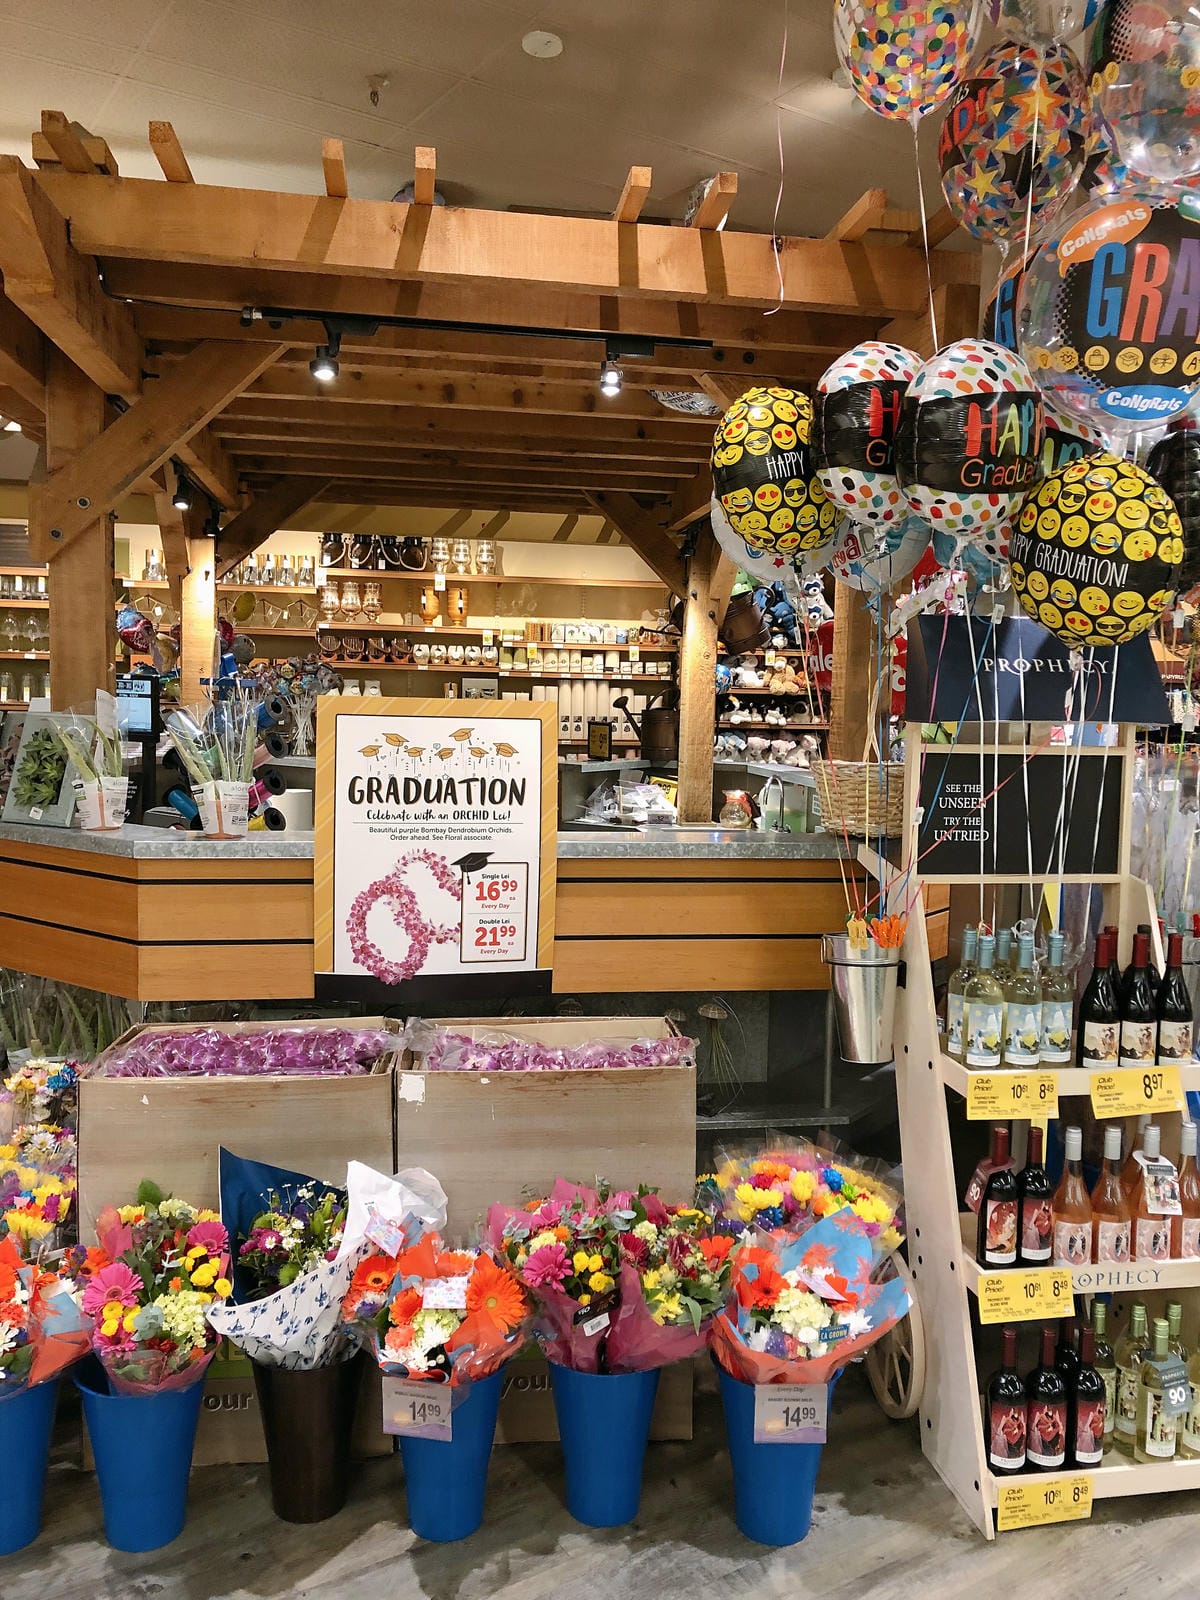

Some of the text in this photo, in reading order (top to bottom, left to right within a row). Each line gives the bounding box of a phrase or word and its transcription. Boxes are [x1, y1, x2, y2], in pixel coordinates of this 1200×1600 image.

[766, 451, 805, 480] HAPPY
[1035, 542, 1129, 588] GRADUATION!
[348, 776, 526, 806] GRADUATION
[945, 783, 983, 793] SEE THE
[939, 796, 987, 809] UNSEEN
[366, 809, 512, 821] Celebrate with an ORCHID Lei!
[943, 816, 982, 826] TRY THE
[934, 829, 989, 842] UNTRIED
[1169, 1386, 1186, 1405] 90
